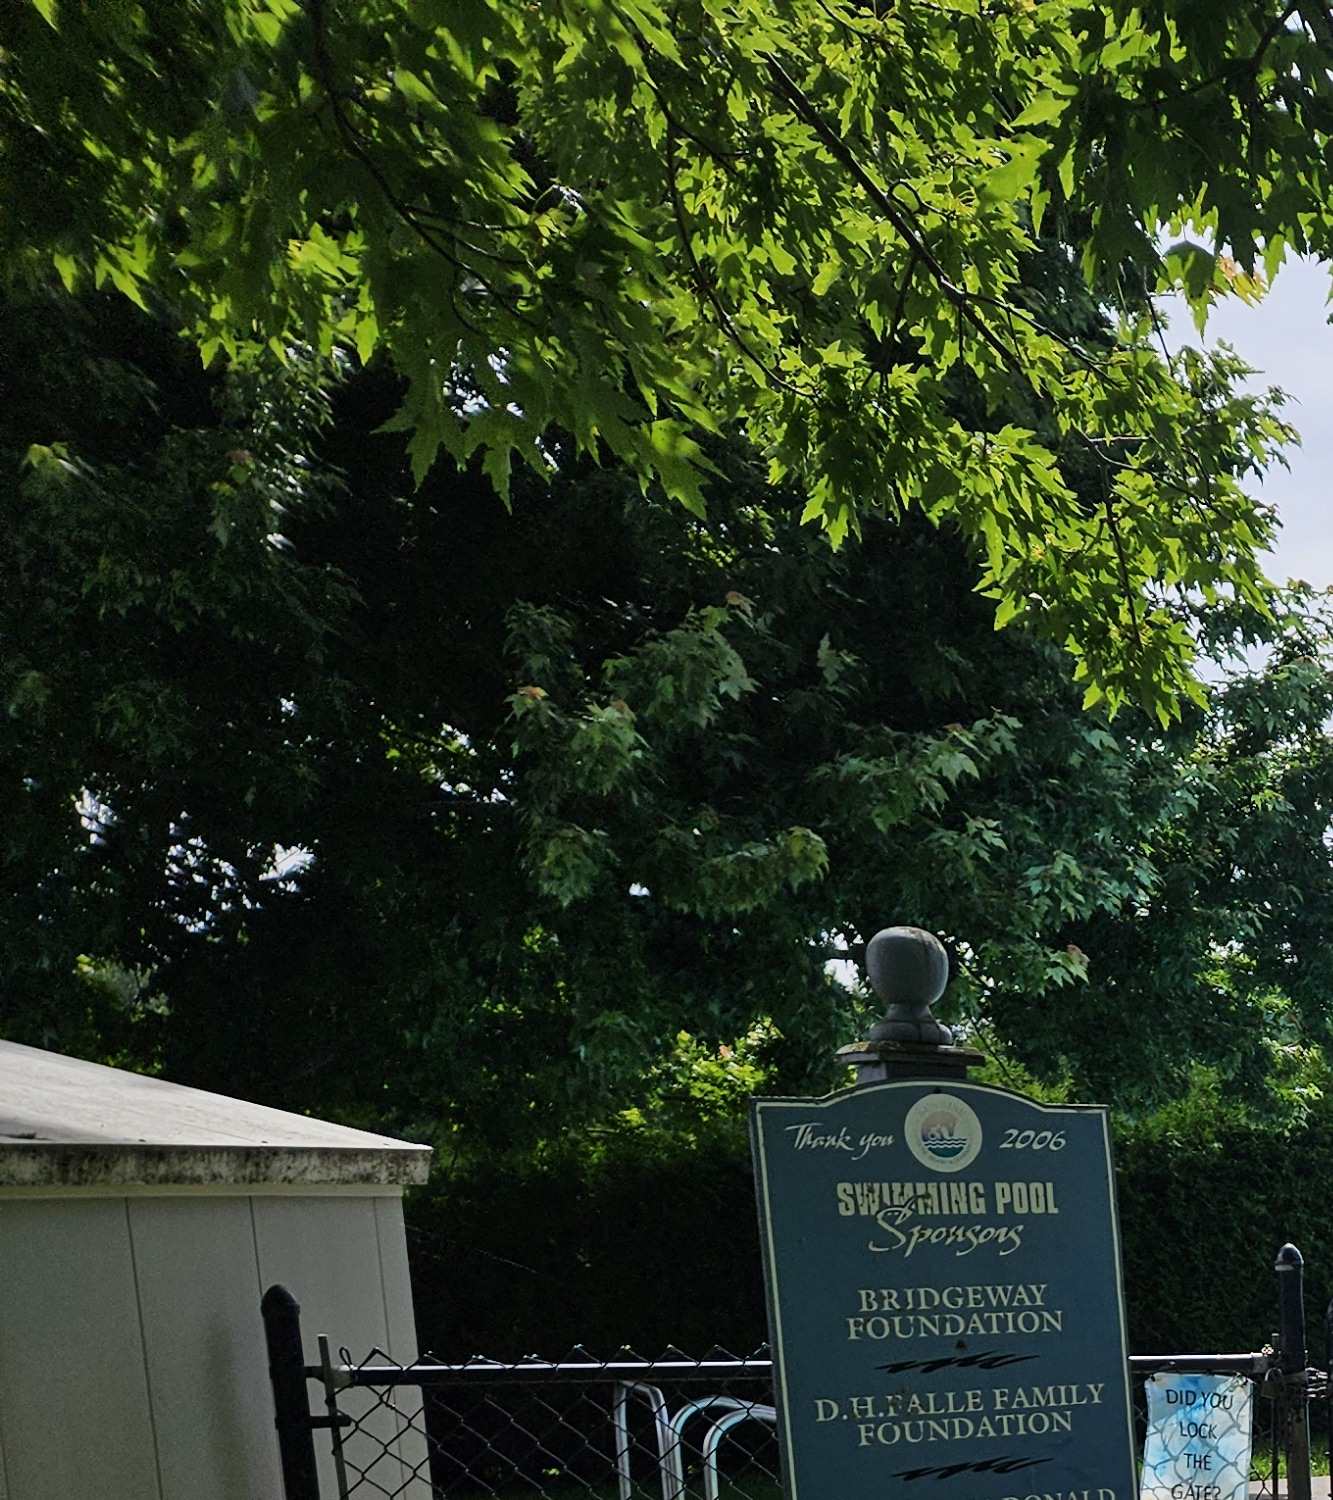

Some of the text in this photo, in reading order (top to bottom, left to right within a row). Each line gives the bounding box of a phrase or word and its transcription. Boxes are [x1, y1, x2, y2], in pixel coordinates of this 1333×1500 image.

[785, 1122, 894, 1160] Thank you
[1000, 1129, 1065, 1151] 2006
[837, 1182, 1059, 1216] SWIMMING POOL
[869, 1195, 1024, 1258] Sponsors
[858, 1284, 1047, 1312] BRIDGEWAY
[847, 1310, 1062, 1341] FOUNDATION
[994, 1383, 1104, 1410] FAMILY
[1166, 1389, 1233, 1410] DID YOU
[857, 1411, 1072, 1446] FOUNDATION
[1180, 1422, 1217, 1439] LOCK
[1184, 1454, 1211, 1470] THE
[1172, 1484, 1221, 1500] GATE?
